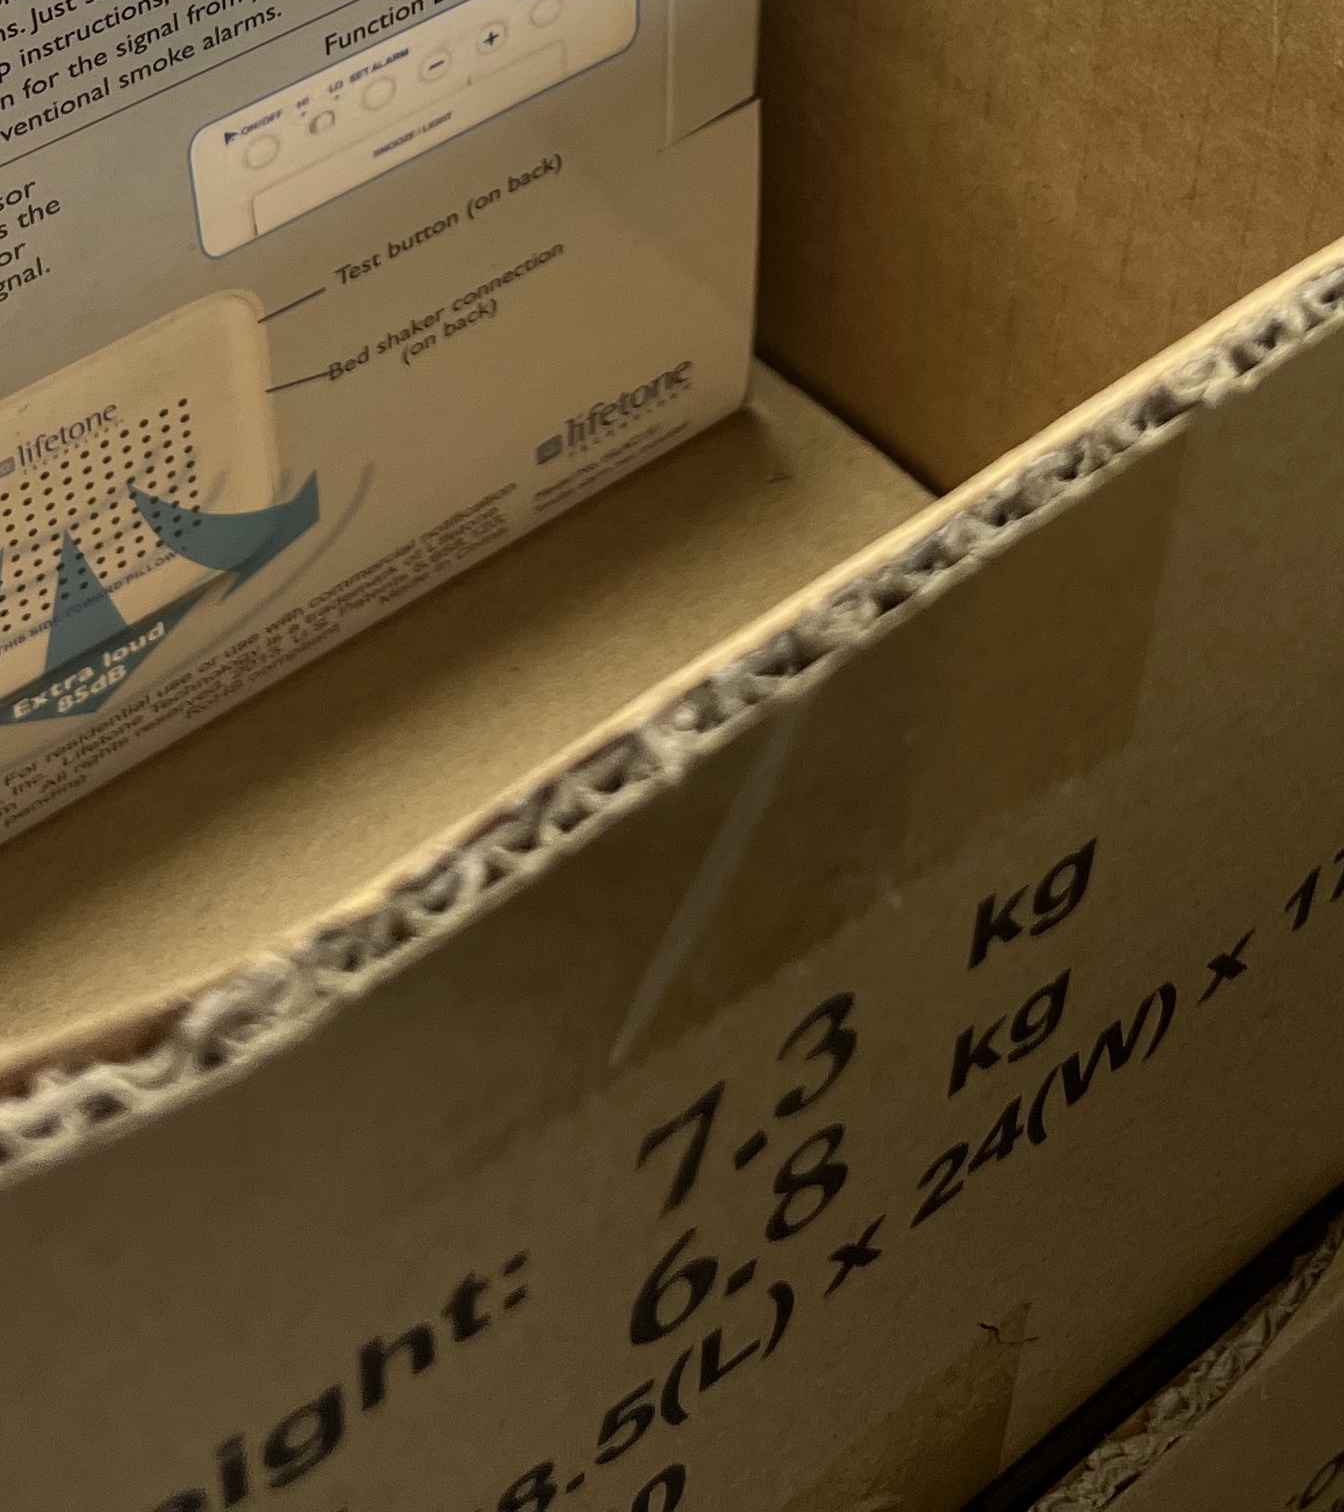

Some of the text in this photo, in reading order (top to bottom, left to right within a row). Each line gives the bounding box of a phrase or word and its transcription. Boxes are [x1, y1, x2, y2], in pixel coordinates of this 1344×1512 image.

[324, 0, 425, 55] Function
[16, 199, 61, 228] the
[334, 153, 562, 285] Test button (on back)
[328, 243, 564, 383] Bed shaker connection
[401, 297, 497, 366] (on back)
[16, 403, 117, 466] lifetone
[13, 622, 165, 721] Extra loud
[58, 665, 127, 714] 85dB
[639, 989, 855, 1217] 7.3
[966, 835, 1097, 971] kg
[629, 968, 1073, 1353] 6.8 kg
[823, 1217, 881, 1302] x
[911, 980, 1179, 1232] 24(W)
[1196, 928, 1251, 1005] x
